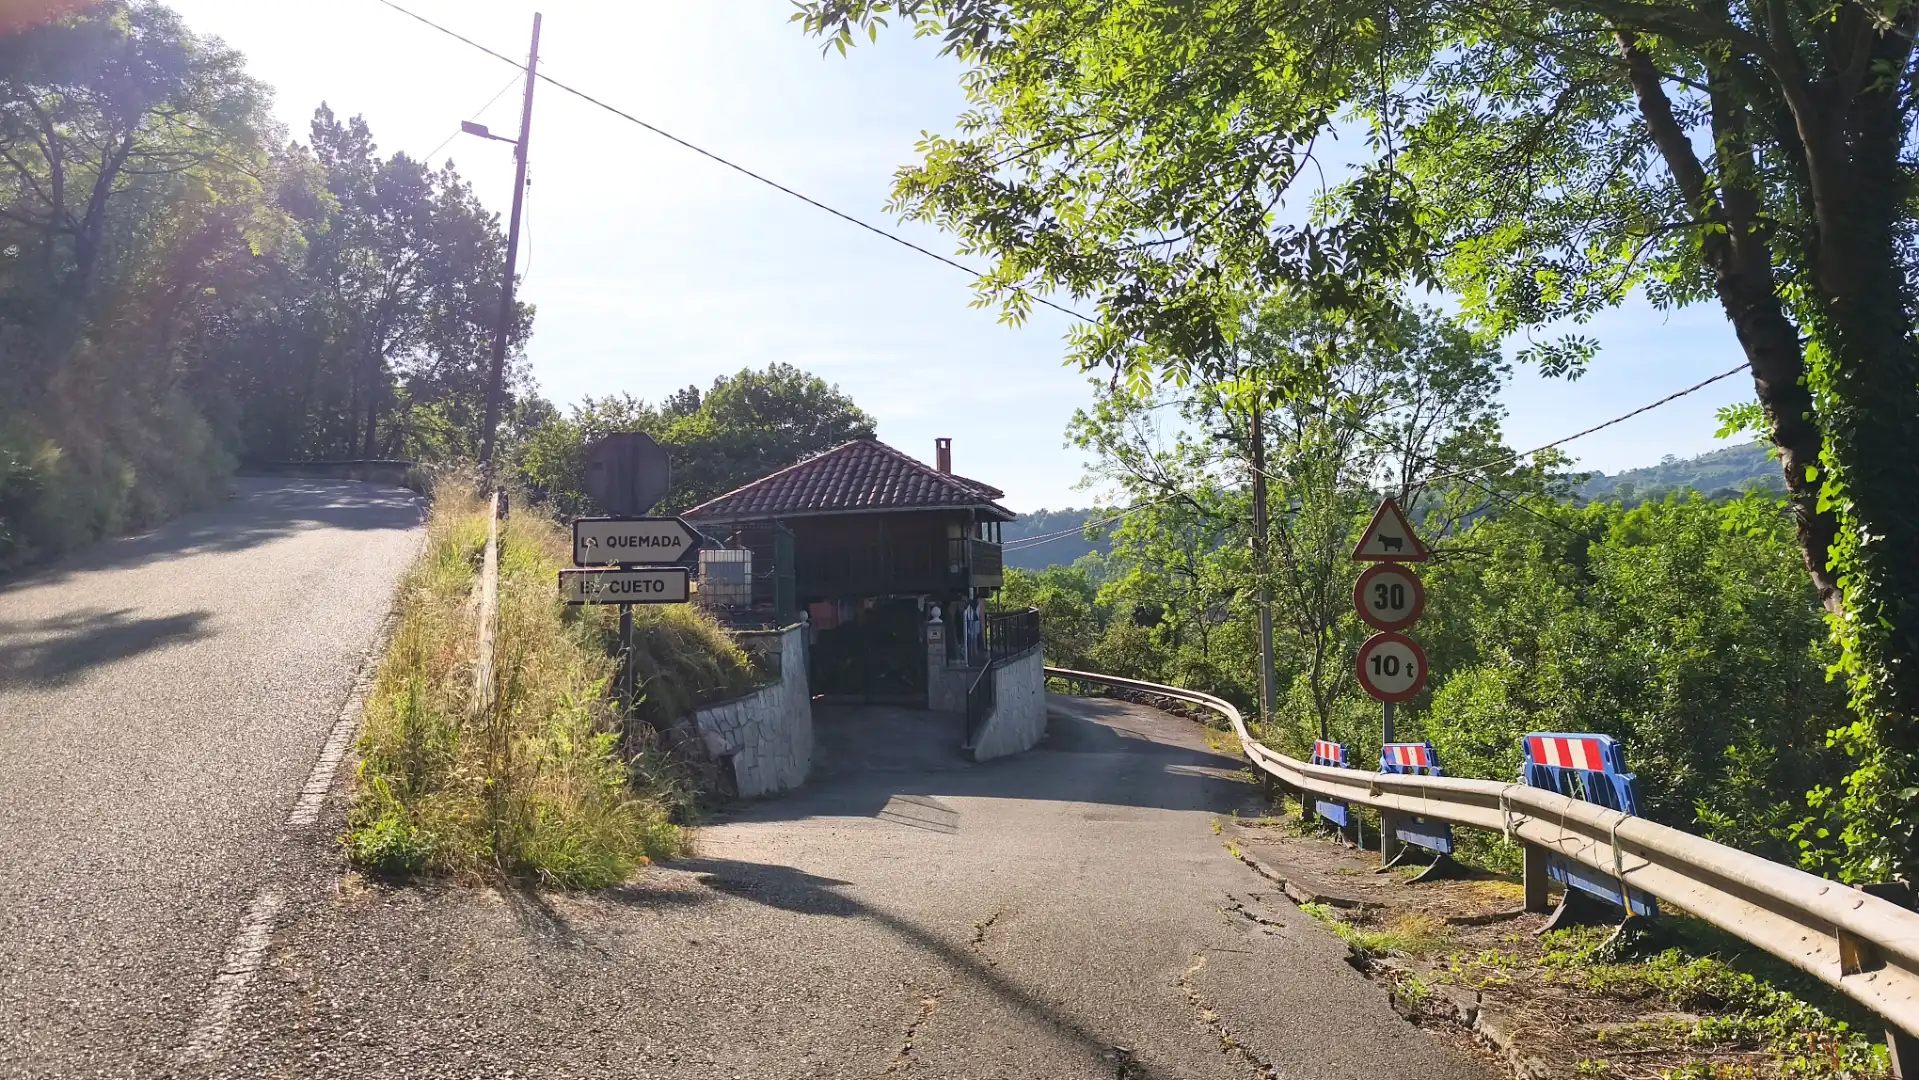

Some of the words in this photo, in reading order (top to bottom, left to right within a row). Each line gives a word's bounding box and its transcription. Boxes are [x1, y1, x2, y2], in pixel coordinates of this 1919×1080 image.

[606, 535, 682, 548] QUEMADA
[609, 580, 665, 593] CUETO
[1374, 583, 1405, 610] 30
[1370, 654, 1400, 677] 10
[1406, 662, 1414, 678] t
